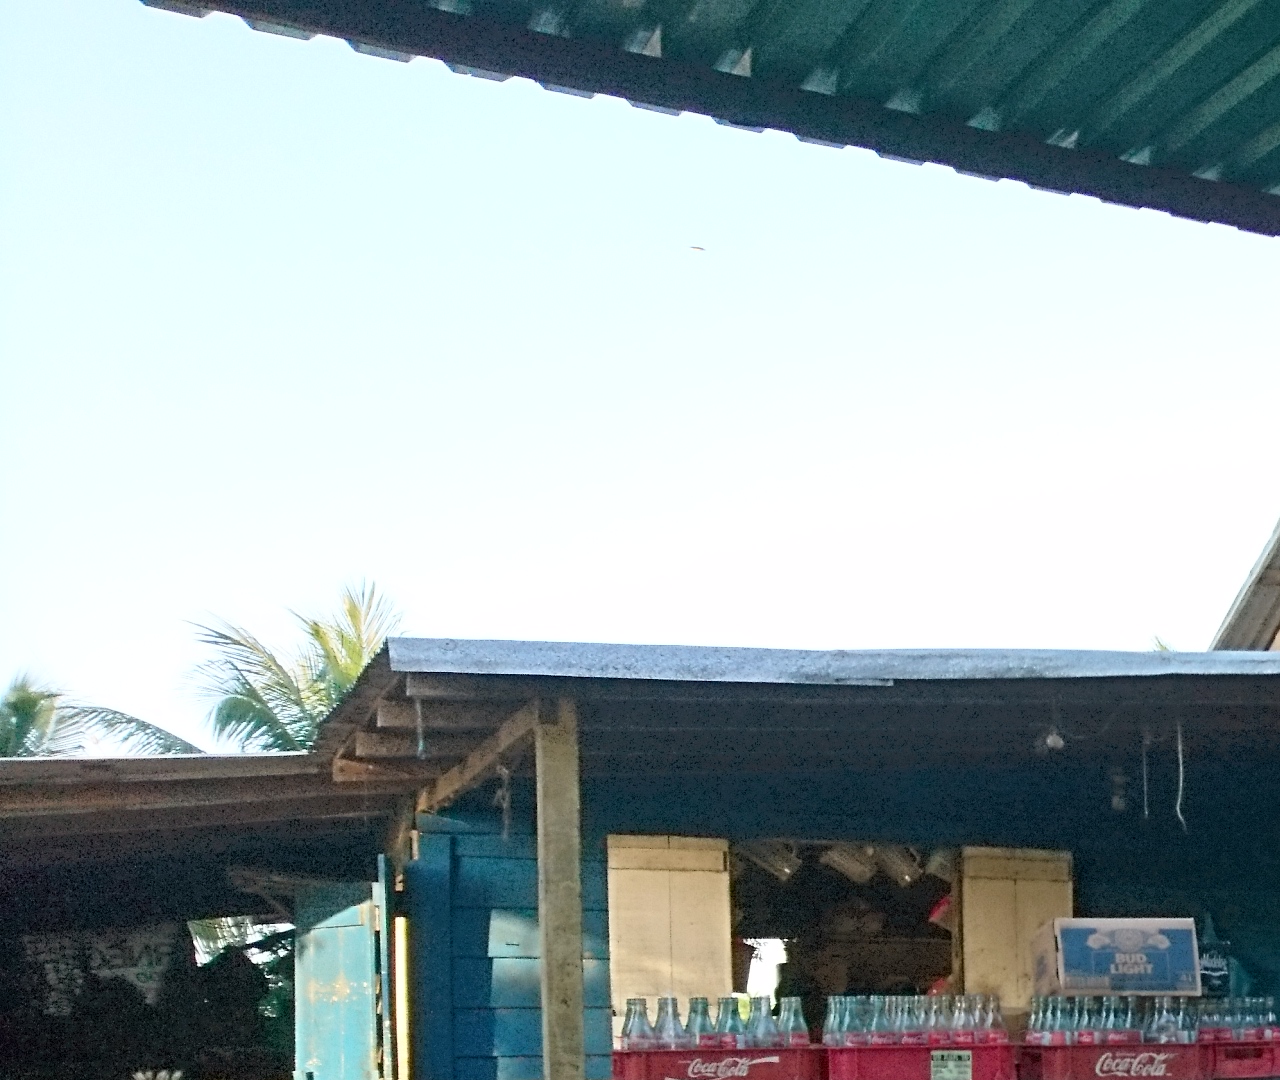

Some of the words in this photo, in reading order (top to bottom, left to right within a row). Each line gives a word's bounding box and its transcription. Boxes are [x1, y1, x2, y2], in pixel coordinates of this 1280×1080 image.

[1115, 953, 1147, 963] BUD
[1110, 963, 1153, 974] LIGHT
[687, 1057, 750, 1078] Coca-Cola
[1096, 1052, 1170, 1077] Coca-Cola
